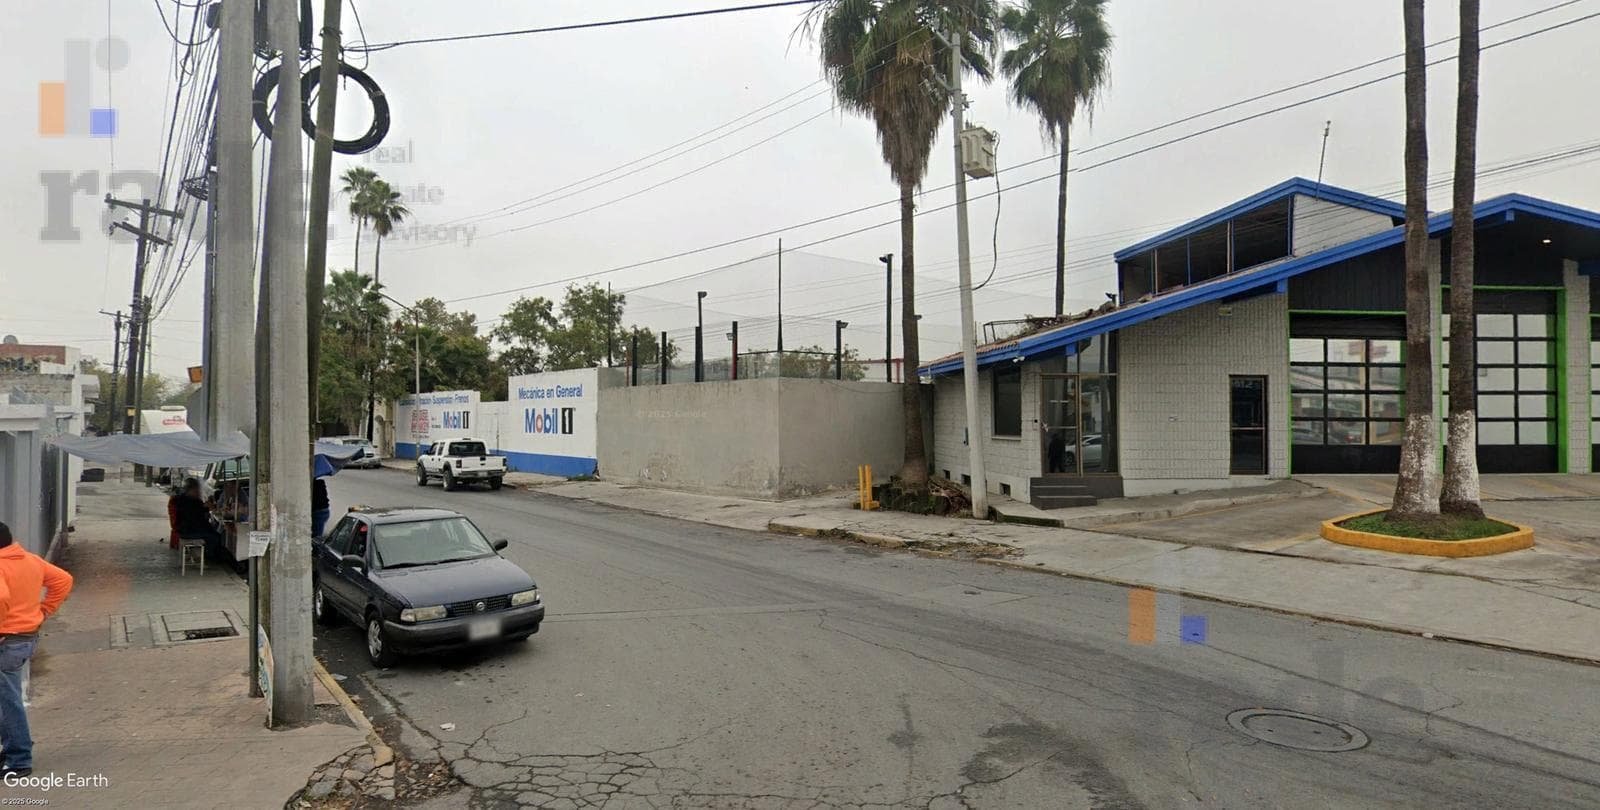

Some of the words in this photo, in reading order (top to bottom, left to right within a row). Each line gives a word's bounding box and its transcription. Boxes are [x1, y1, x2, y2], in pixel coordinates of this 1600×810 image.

[546, 388, 555, 399] en
[556, 384, 583, 398] General
[443, 410, 462, 429] Mobil
[525, 407, 558, 434] Mobil
